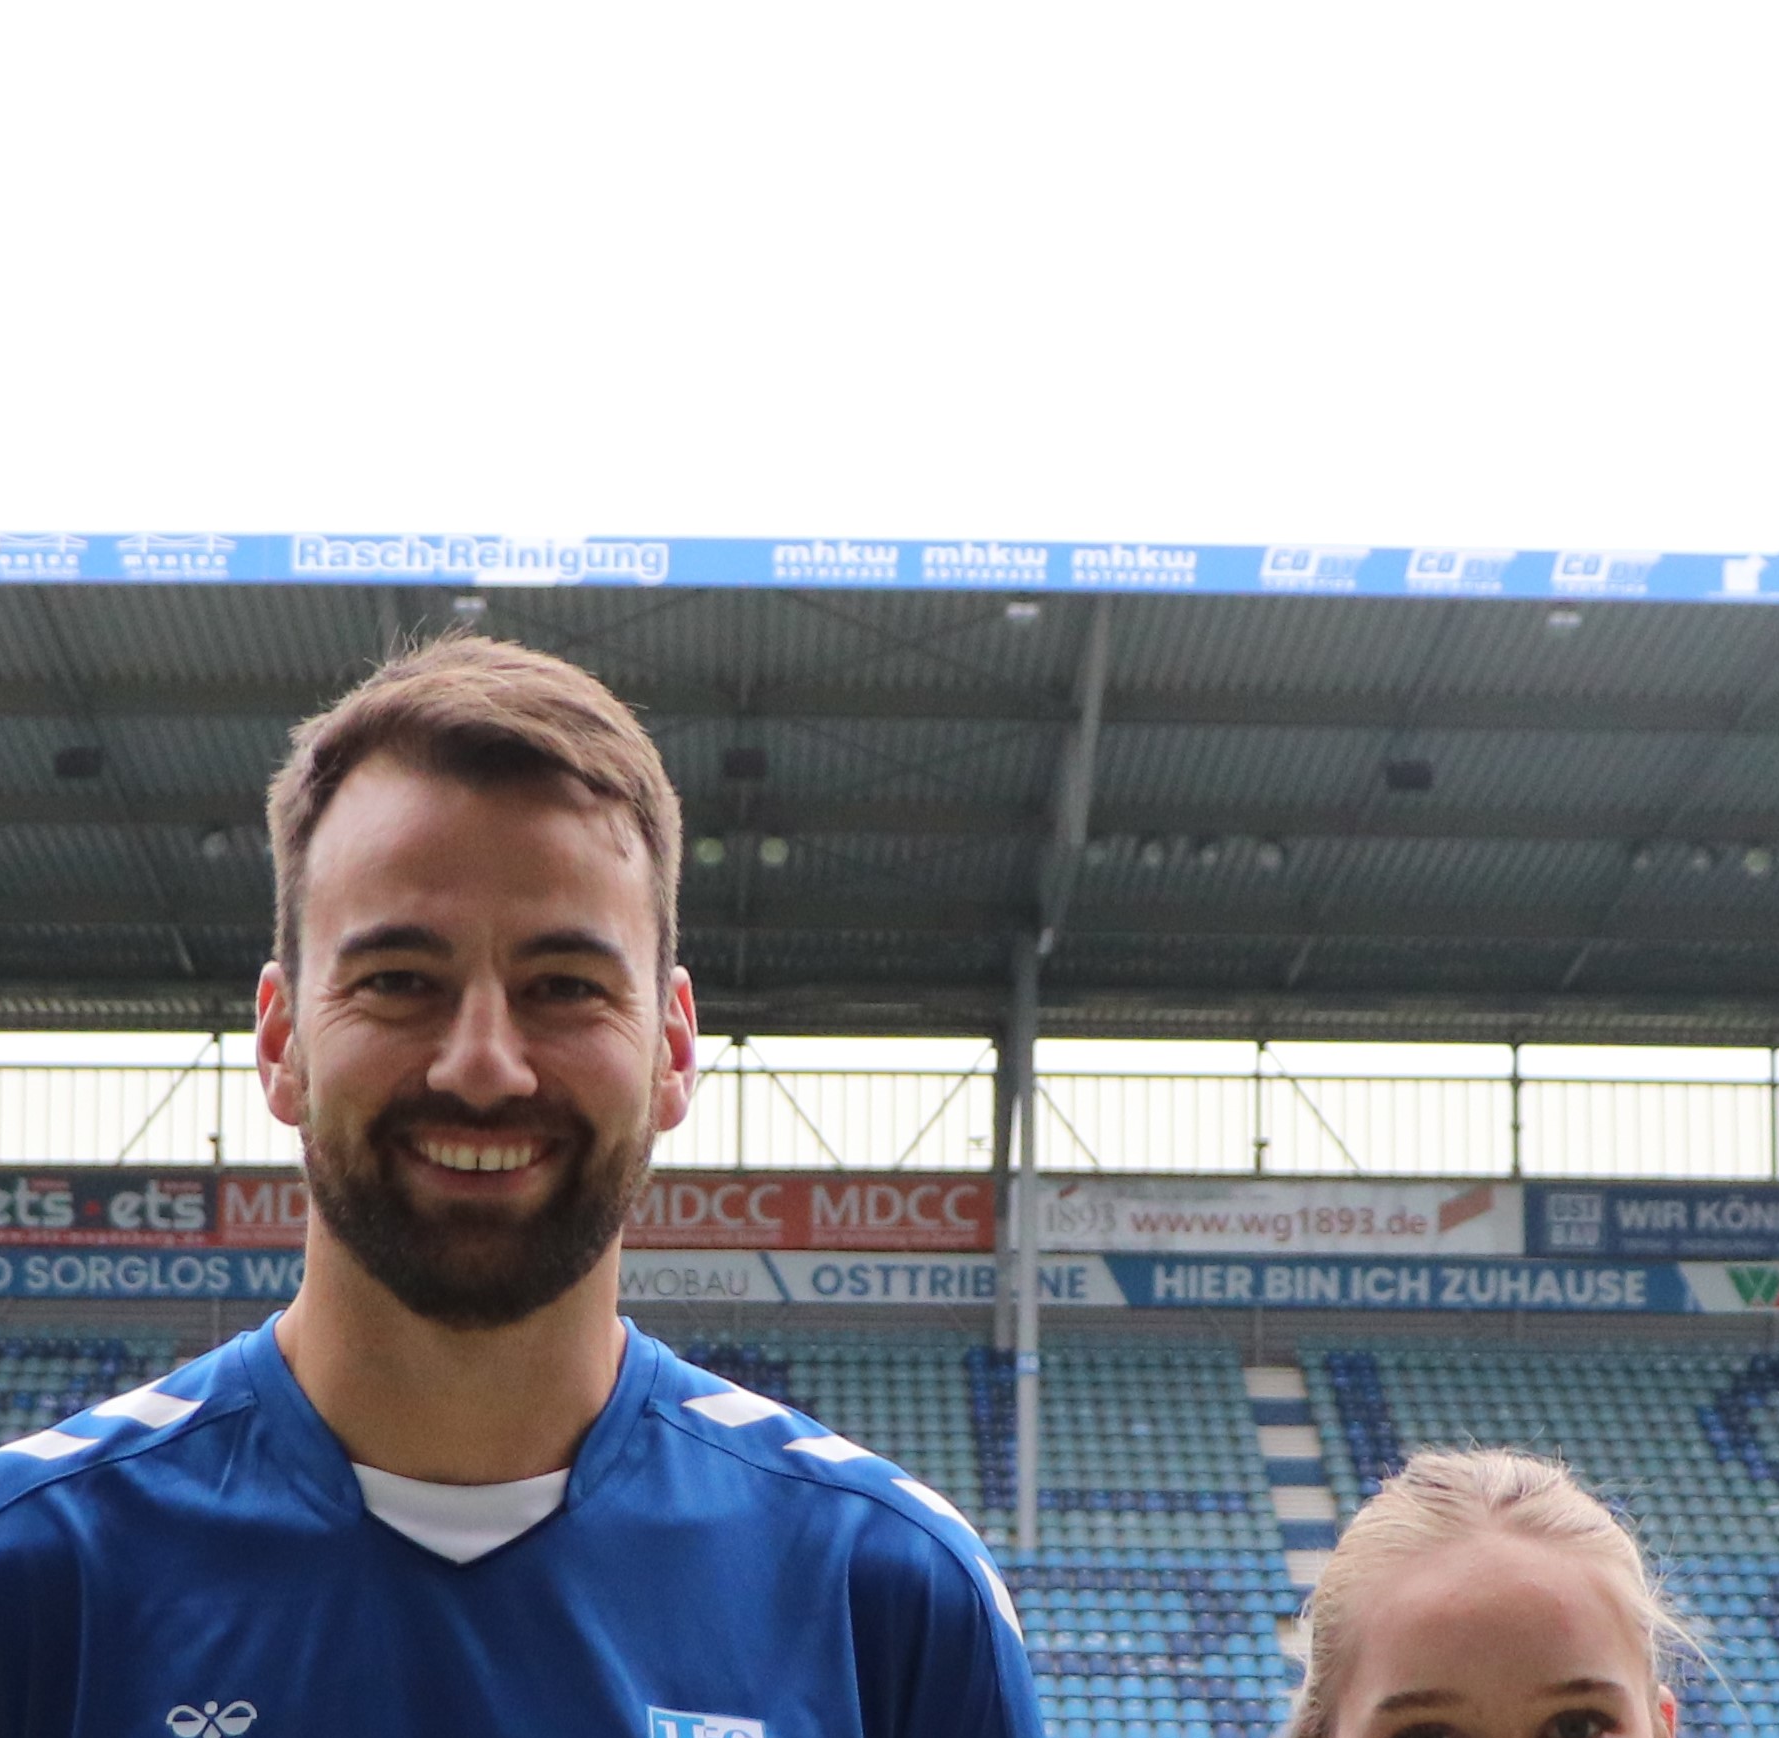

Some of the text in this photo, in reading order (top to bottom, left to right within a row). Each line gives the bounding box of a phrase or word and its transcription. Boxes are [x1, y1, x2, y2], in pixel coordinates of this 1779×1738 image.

[292, 534, 670, 585] Rasch-Reinigung
[773, 540, 899, 564] mhkw
[922, 541, 1047, 566] mhkw
[1072, 544, 1197, 568] mhkw
[109, 1178, 207, 1230] ets
[630, 1182, 783, 1229] MDCC
[810, 1183, 980, 1230] MDCC
[1617, 1202, 1688, 1232] WIR
[1131, 1208, 1427, 1242] www.wg1893.de
[25, 1253, 232, 1292] SORGLOS
[619, 1267, 750, 1297] WOBAU
[811, 1262, 1087, 1298] OSTTRIBNE
[1153, 1264, 1648, 1301] HIER BIN ICH ZUHAUSE
